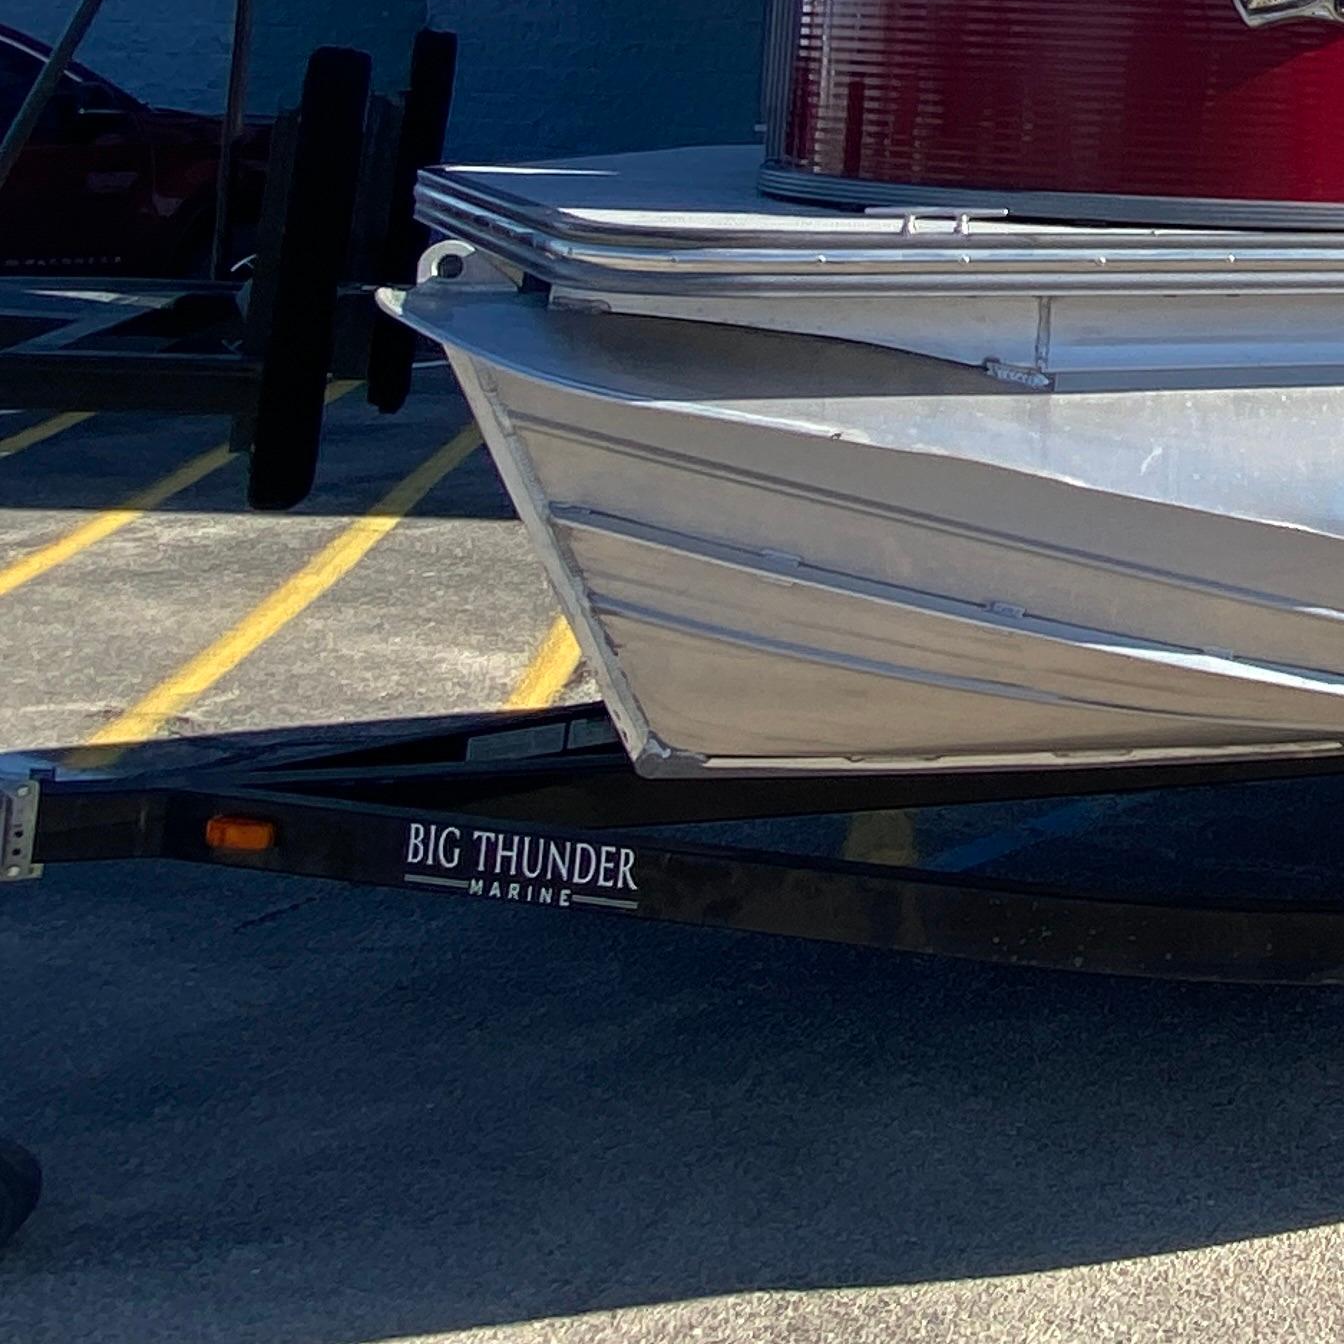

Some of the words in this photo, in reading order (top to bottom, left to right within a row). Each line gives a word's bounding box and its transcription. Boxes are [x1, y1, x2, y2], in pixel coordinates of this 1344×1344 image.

[407, 823, 461, 868] BIG
[473, 830, 639, 891] THUNDER
[468, 879, 572, 906] MARINE
